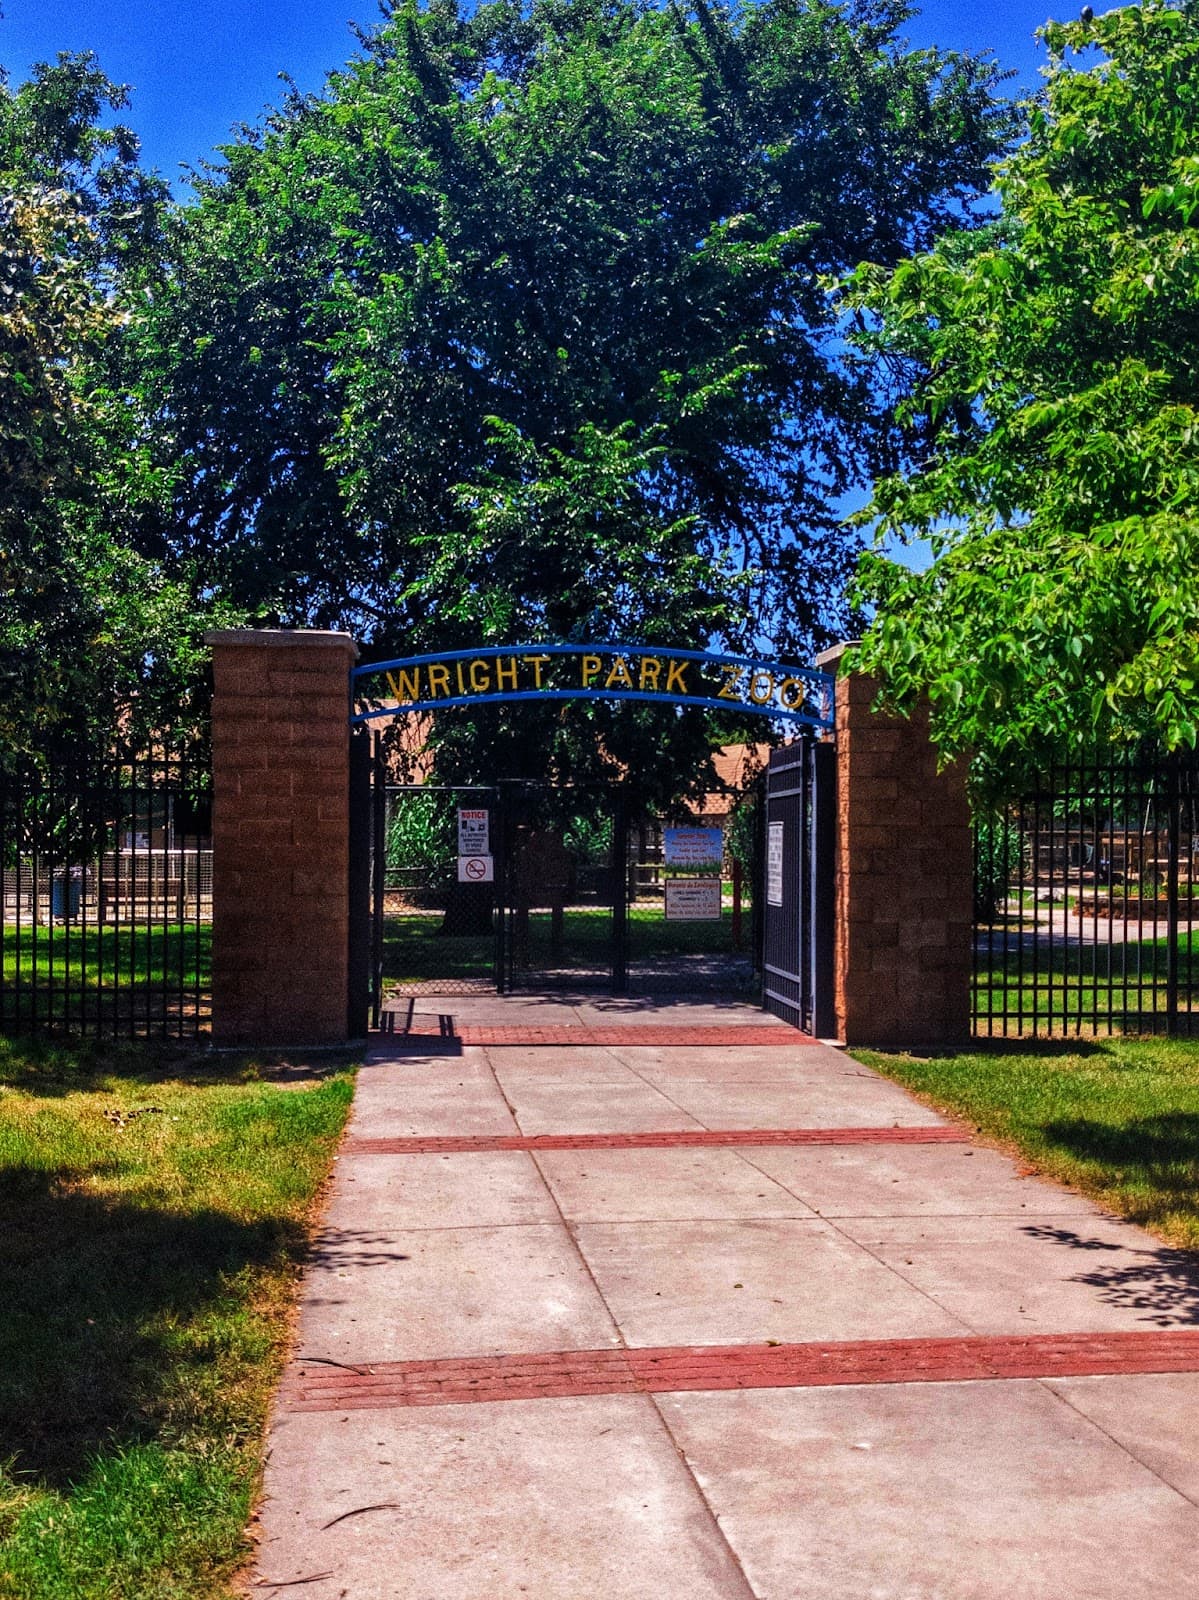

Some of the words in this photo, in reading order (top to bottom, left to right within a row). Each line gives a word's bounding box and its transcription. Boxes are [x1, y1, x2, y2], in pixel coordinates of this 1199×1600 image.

[386, 656, 551, 701] WRIGHT
[582, 655, 692, 694] PARK
[717, 665, 803, 709] ZOO
[461, 811, 486, 819] NOTICE
